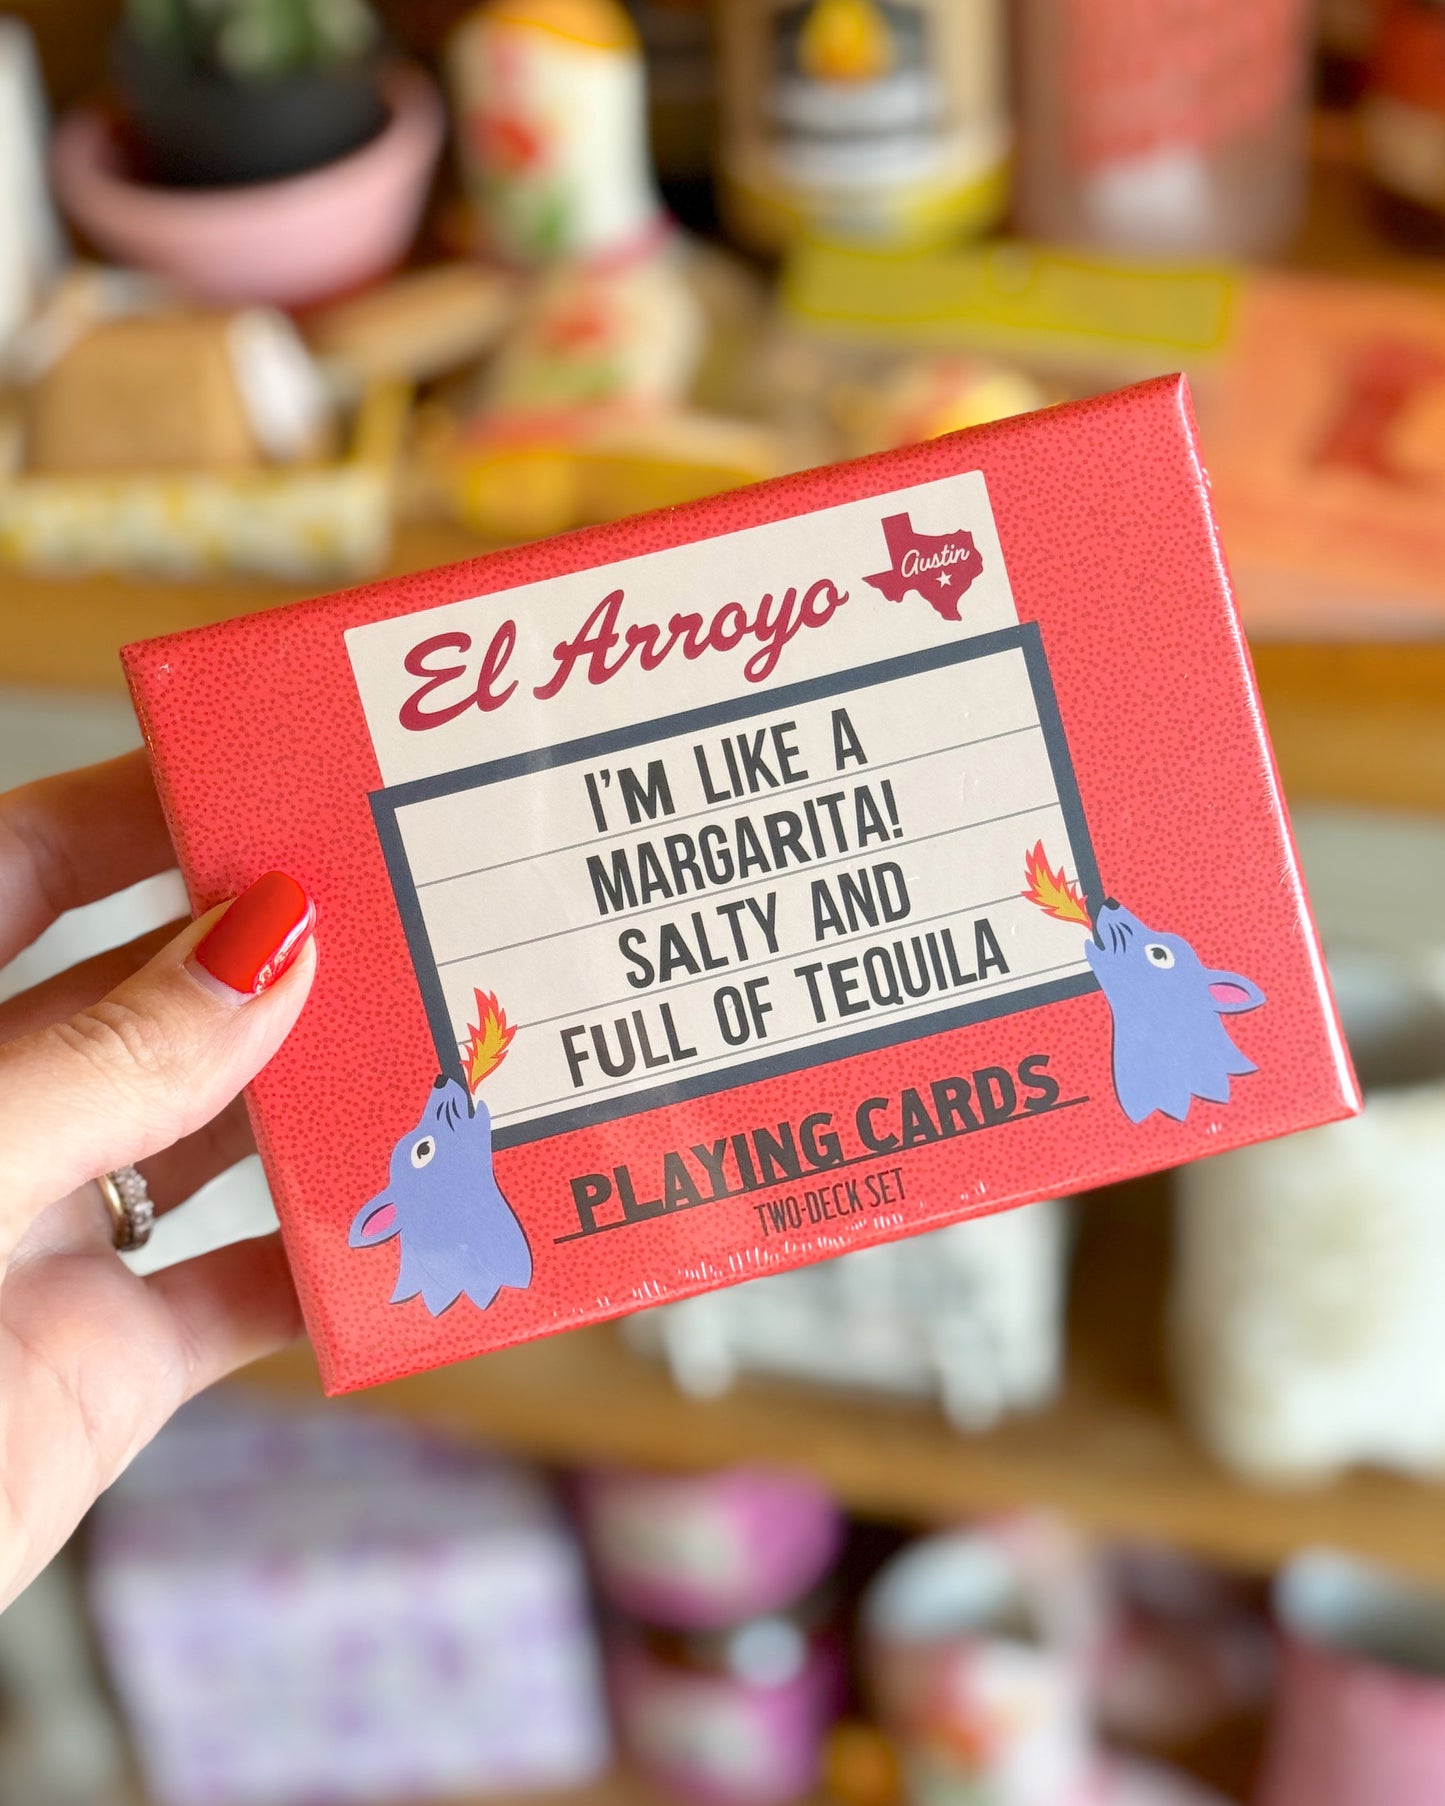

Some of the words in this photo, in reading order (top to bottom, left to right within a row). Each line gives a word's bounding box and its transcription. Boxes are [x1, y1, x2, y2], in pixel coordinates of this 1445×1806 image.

[901, 544, 970, 578] Austin
[399, 619, 518, 731] El
[533, 579, 849, 700] Arroyo
[584, 760, 677, 833] I'M
[693, 721, 809, 804] LIKE
[831, 708, 868, 768] A
[586, 780, 904, 915] MARGARITA!
[618, 892, 779, 989] SALTY
[811, 861, 911, 941] AND
[560, 1003, 697, 1088] FULL
[713, 976, 773, 1045] OF
[795, 918, 1010, 1024] TEQUILA
[569, 1113, 841, 1233] PLAYING
[854, 1055, 1060, 1151] CARDS
[754, 1181, 865, 1237] TWO-DECK
[868, 1169, 908, 1209] SET
